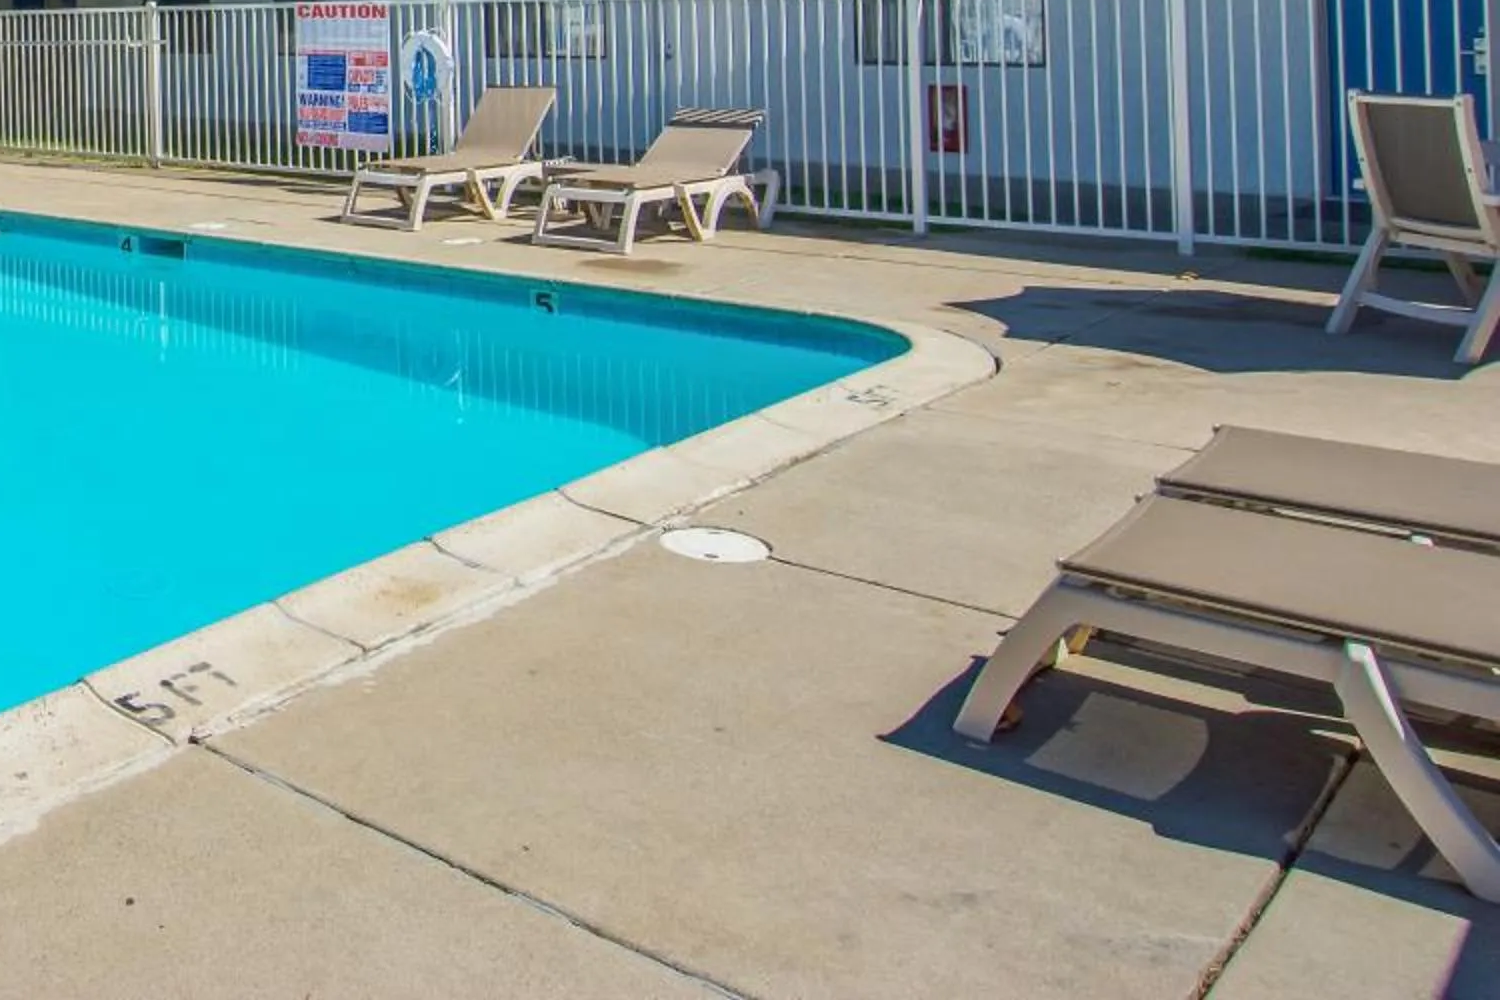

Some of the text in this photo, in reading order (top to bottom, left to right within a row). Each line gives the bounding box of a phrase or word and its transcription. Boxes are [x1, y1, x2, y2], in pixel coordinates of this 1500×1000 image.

[297, 3, 387, 19] CAUTION
[121, 236, 132, 252] 4
[535, 291, 554, 314] 5
